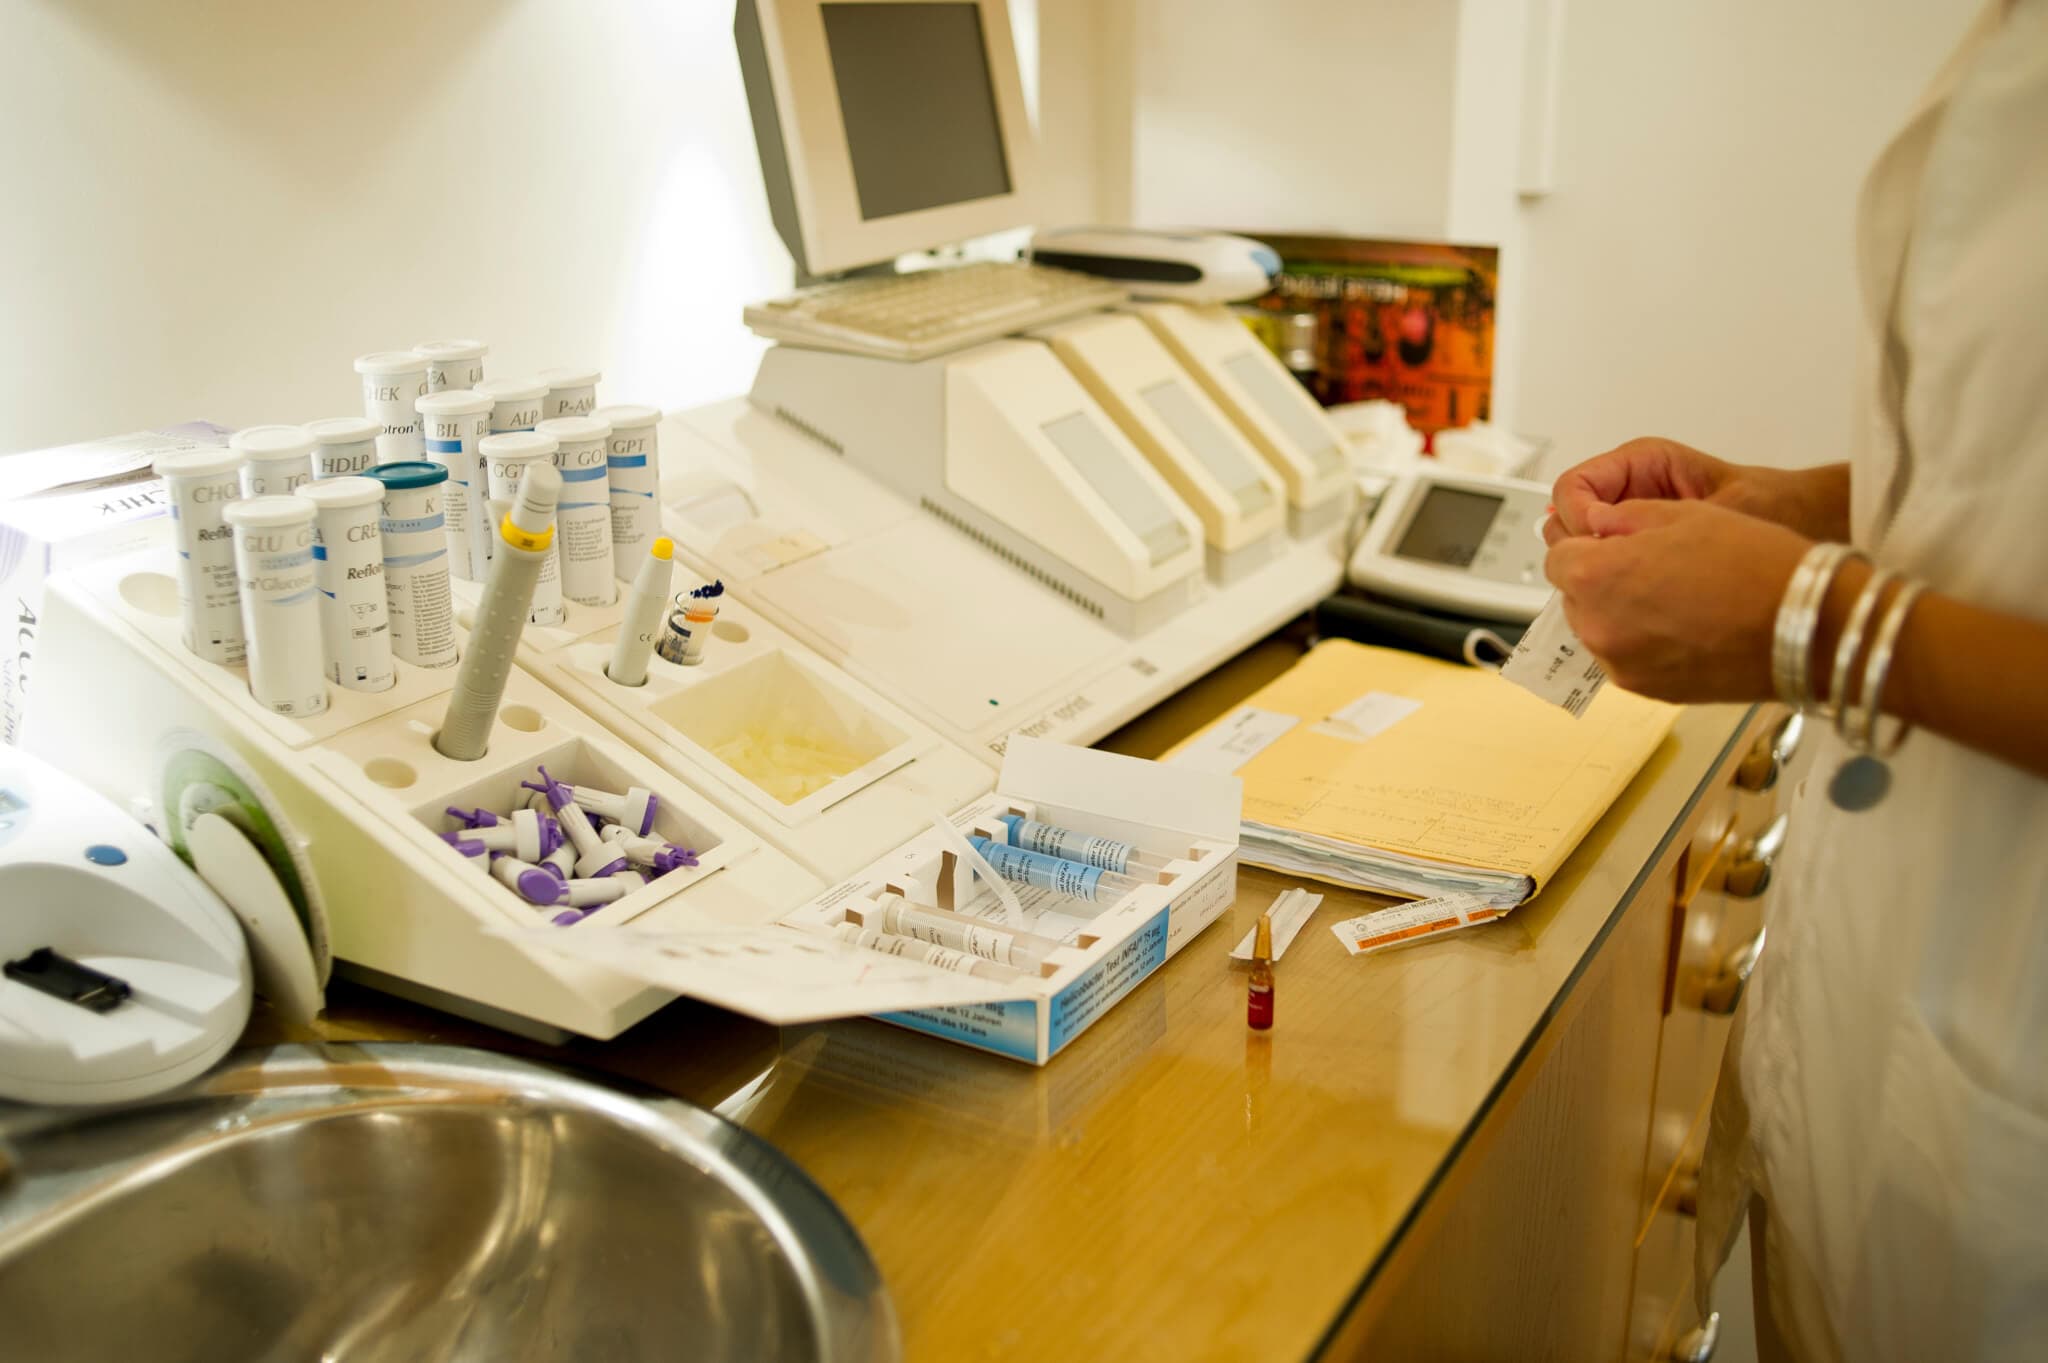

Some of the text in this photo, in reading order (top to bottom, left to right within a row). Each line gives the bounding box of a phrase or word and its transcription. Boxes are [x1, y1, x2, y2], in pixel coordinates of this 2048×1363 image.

[511, 410, 538, 427] ALP
[437, 422, 463, 438] BIL
[613, 439, 646, 458] GPT
[321, 455, 370, 474] HDLP
